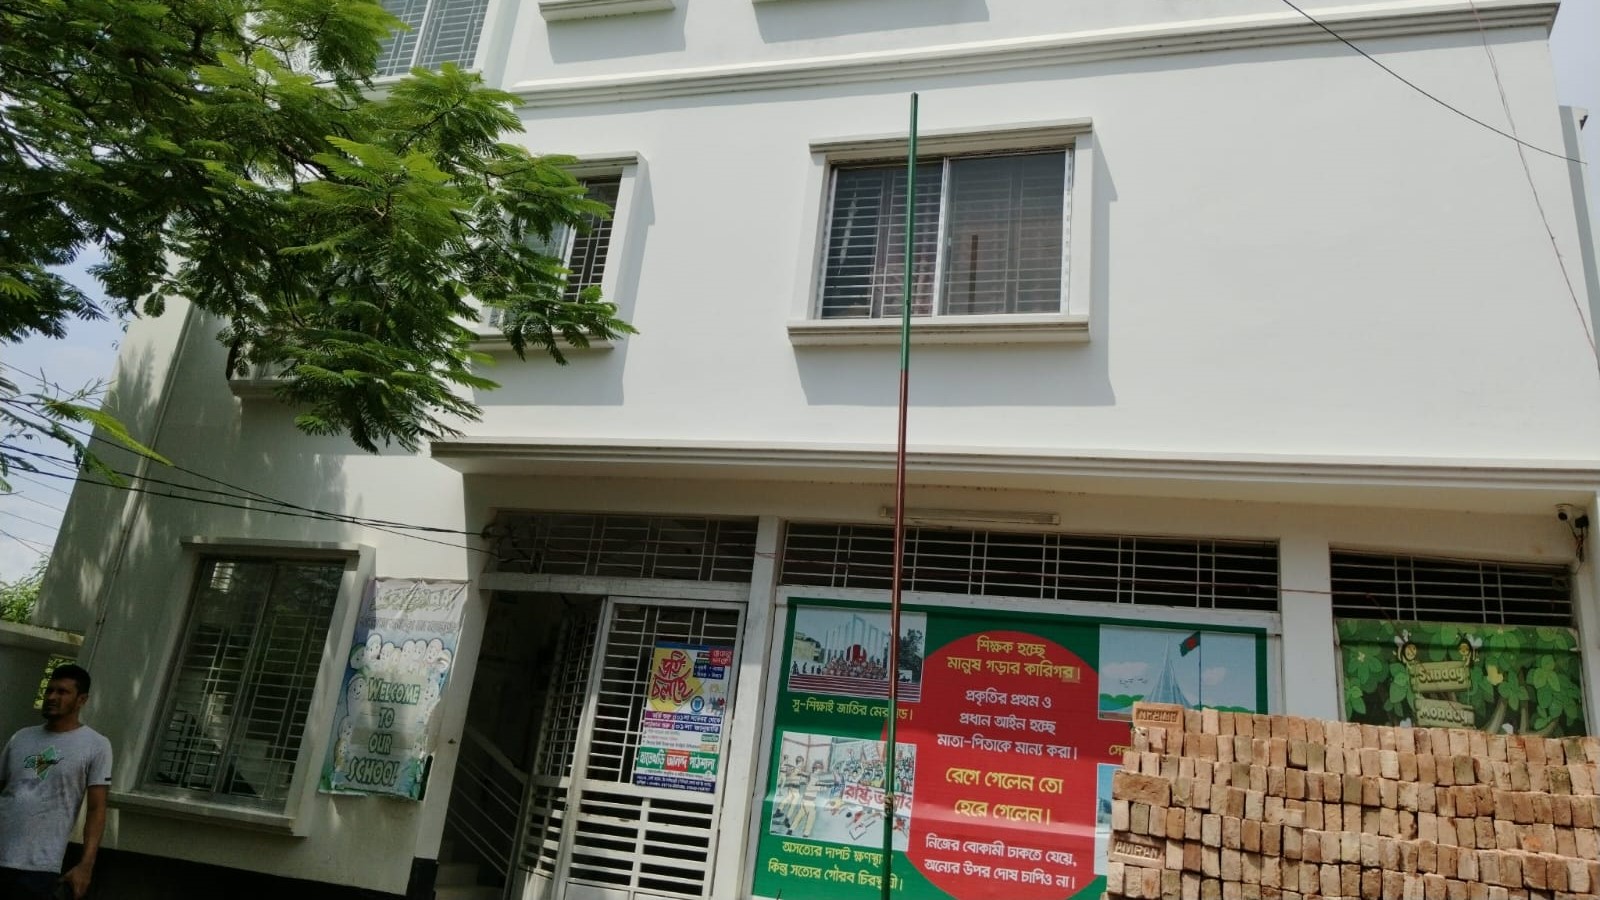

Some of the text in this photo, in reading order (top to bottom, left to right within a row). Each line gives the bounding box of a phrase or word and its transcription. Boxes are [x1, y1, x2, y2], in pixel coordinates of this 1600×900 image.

[976, 635, 1047, 659] শিক্ষক হচ্ছে
[947, 656, 1081, 681] মানুষ গড়ার কারিগর।
[1418, 667, 1466, 685] Sunday
[368, 677, 421, 705] WELCOME
[965, 687, 1053, 709] প্রকৃতির প্রথম ও
[378, 707, 395, 728] TO
[837, 700, 868, 716] জাতির
[1418, 706, 1468, 724] Monday
[959, 712, 1057, 735] প্রধান আইন হচ্ছে
[368, 732, 392, 755] OUR
[937, 733, 1011, 752] মাতা-পিতাকে
[1015, 741, 1043, 756] মান্য
[346, 756, 400, 786] SCHOOL
[946, 767, 1064, 794] রেগে গেলেন তো
[954, 800, 1050, 825] হেরে গেলেন।
[783, 841, 823, 857] অসত্যের
[825, 846, 851, 860] দাপট
[925, 833, 960, 851] নিজের
[963, 841, 1004, 857] বোকামী
[1115, 841, 1159, 859] AMIRAN
[768, 858, 788, 875] কিন্তু
[790, 865, 822, 879] সত্যের
[824, 864, 855, 883] গৌরব
[924, 859, 960, 874] অন্যের
[963, 861, 991, 878] উপর
[994, 868, 1018, 882] দোষ
[1021, 870, 1052, 886] চাপিও
